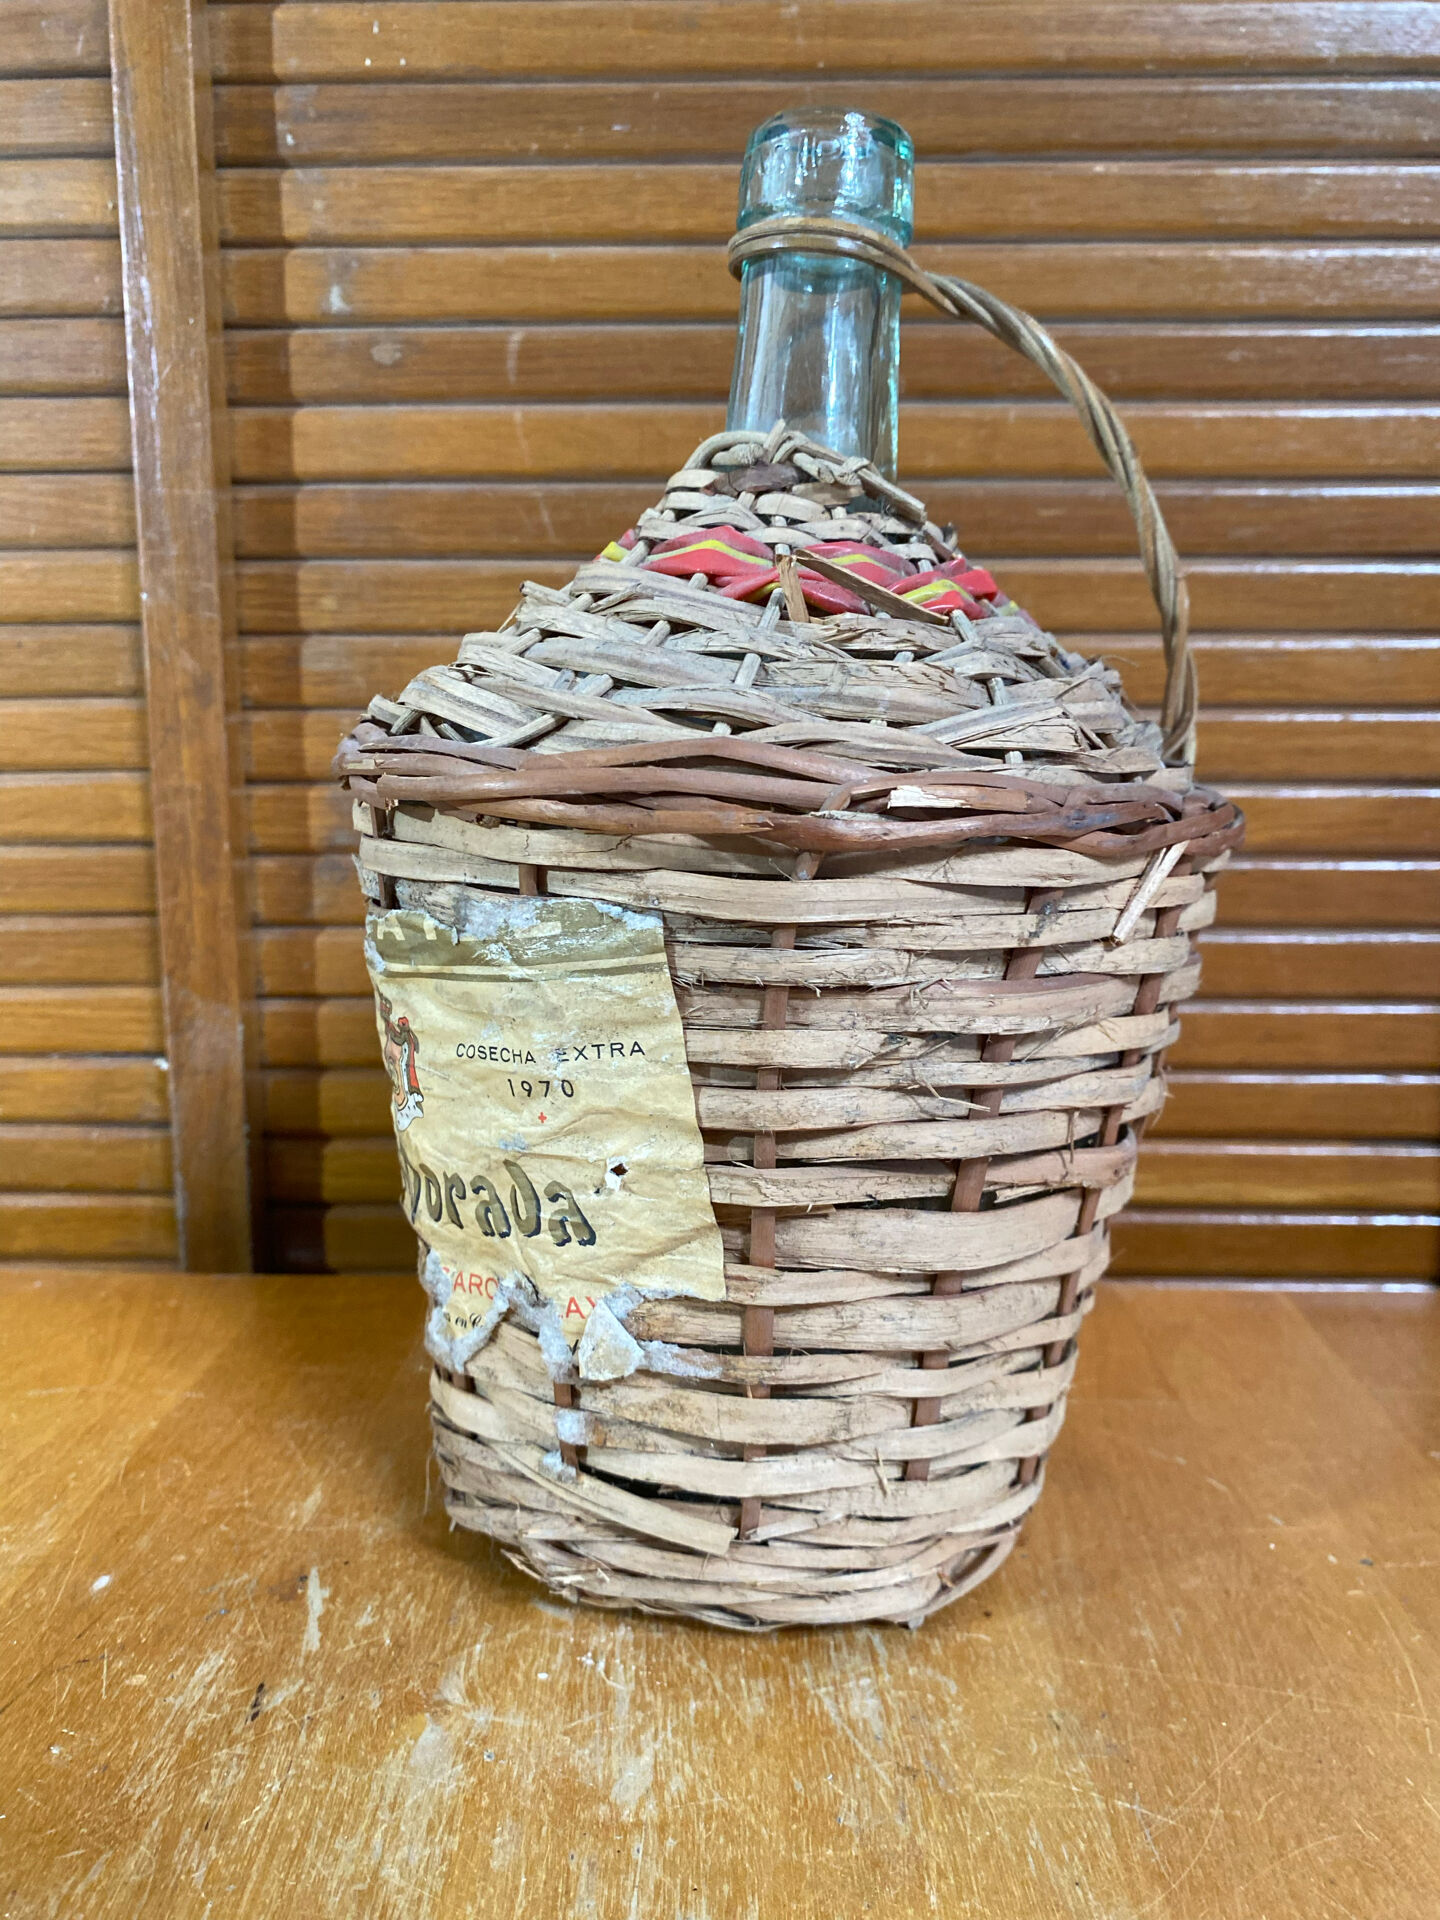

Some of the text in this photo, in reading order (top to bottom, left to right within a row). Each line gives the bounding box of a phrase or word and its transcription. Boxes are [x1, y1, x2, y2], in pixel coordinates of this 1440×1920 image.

[455, 1040, 646, 1065] COSECHA EXTRA
[507, 1078, 575, 1098] 1970
